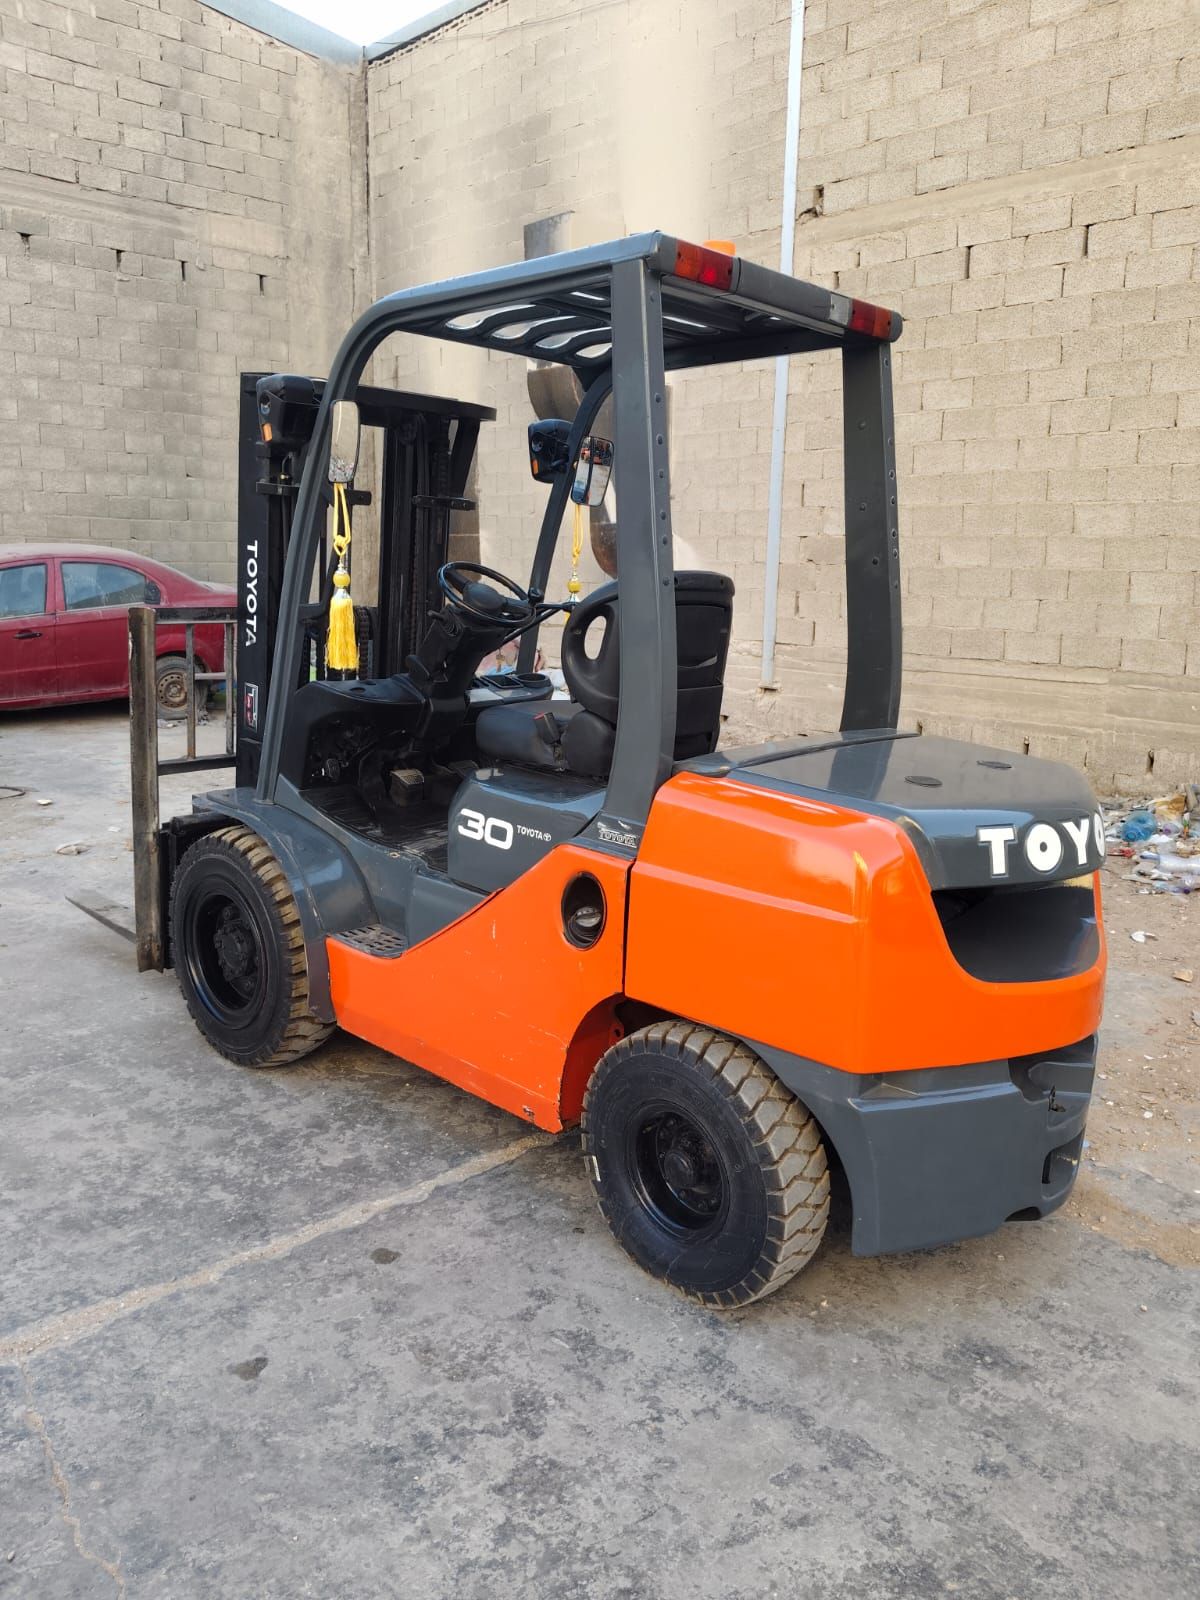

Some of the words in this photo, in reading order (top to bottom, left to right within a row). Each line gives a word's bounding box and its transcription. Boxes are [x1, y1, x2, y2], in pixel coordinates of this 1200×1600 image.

[245, 539, 258, 647] TOYOTA
[457, 808, 514, 850] 30
[516, 824, 543, 841] TOYOTA
[599, 830, 637, 847] TOYOTA
